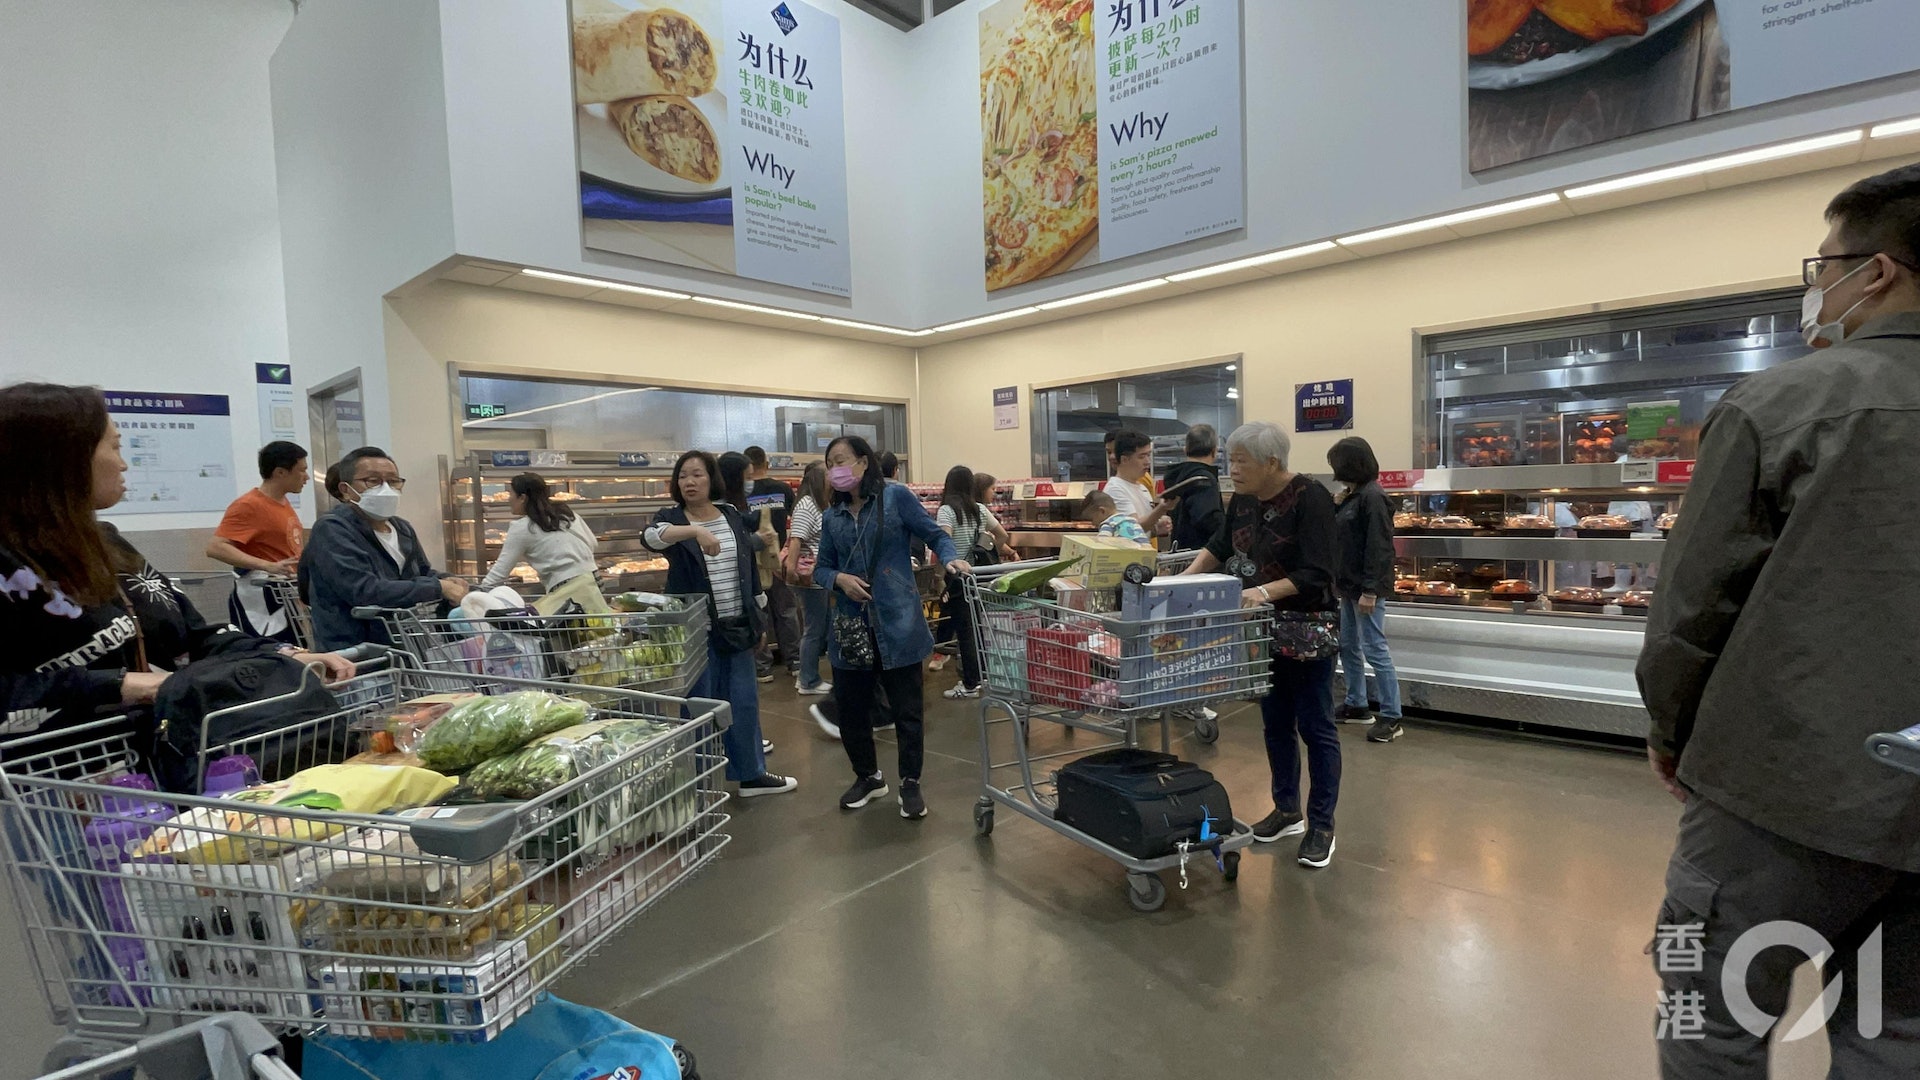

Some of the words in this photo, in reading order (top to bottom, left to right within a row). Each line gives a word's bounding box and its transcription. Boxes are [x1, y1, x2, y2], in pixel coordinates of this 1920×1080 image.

[1762, 4, 1780, 15] for
[1762, 8, 1817, 30] stringent
[1108, 5, 1201, 61] 披萨每2小时
[737, 30, 814, 91] 为什么
[739, 67, 809, 109] 牛肉卷如此
[1109, 111, 1170, 147] Why
[1110, 160, 1117, 171] is
[1119, 152, 1145, 168] Sam's
[1147, 146, 1173, 161] pizza
[1174, 125, 1218, 150] renewed
[742, 145, 796, 190] Why
[1110, 169, 1135, 183] every
[1137, 164, 1144, 175] 2
[1146, 153, 1178, 172] hours?
[744, 181, 751, 193] is
[752, 184, 777, 200] Sam's
[778, 191, 796, 205] beef
[744, 195, 783, 212] popular?
